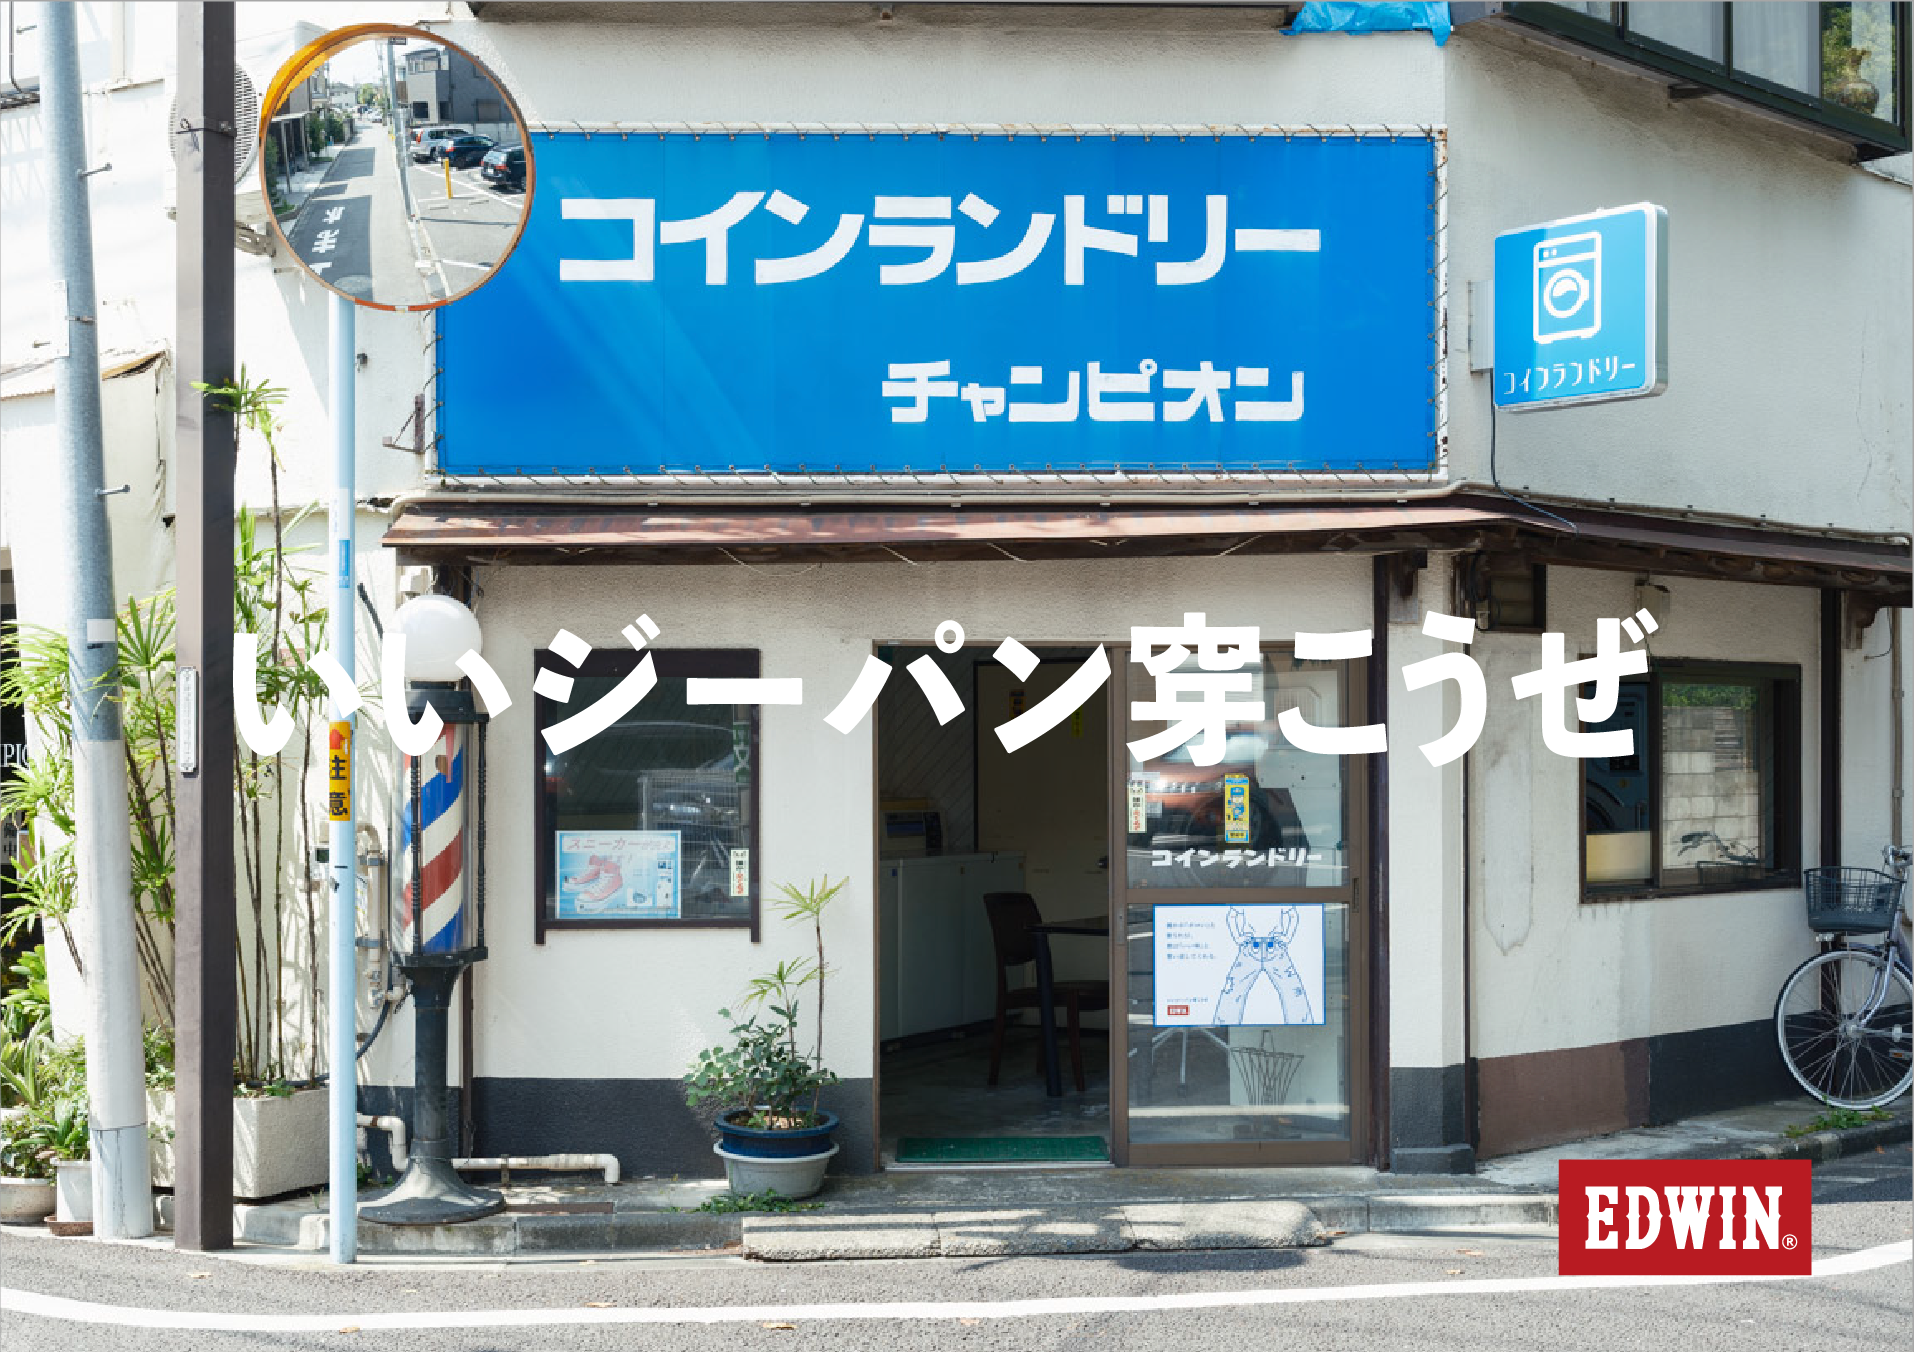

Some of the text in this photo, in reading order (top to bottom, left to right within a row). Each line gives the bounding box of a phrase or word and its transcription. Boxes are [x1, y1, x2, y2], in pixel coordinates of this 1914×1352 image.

[559, 190, 1321, 286] コインランドリー
[881, 358, 1305, 423] チャンピオン
[1503, 355, 1636, 395] コインランドリー
[1151, 847, 1323, 870] コインランドリー
